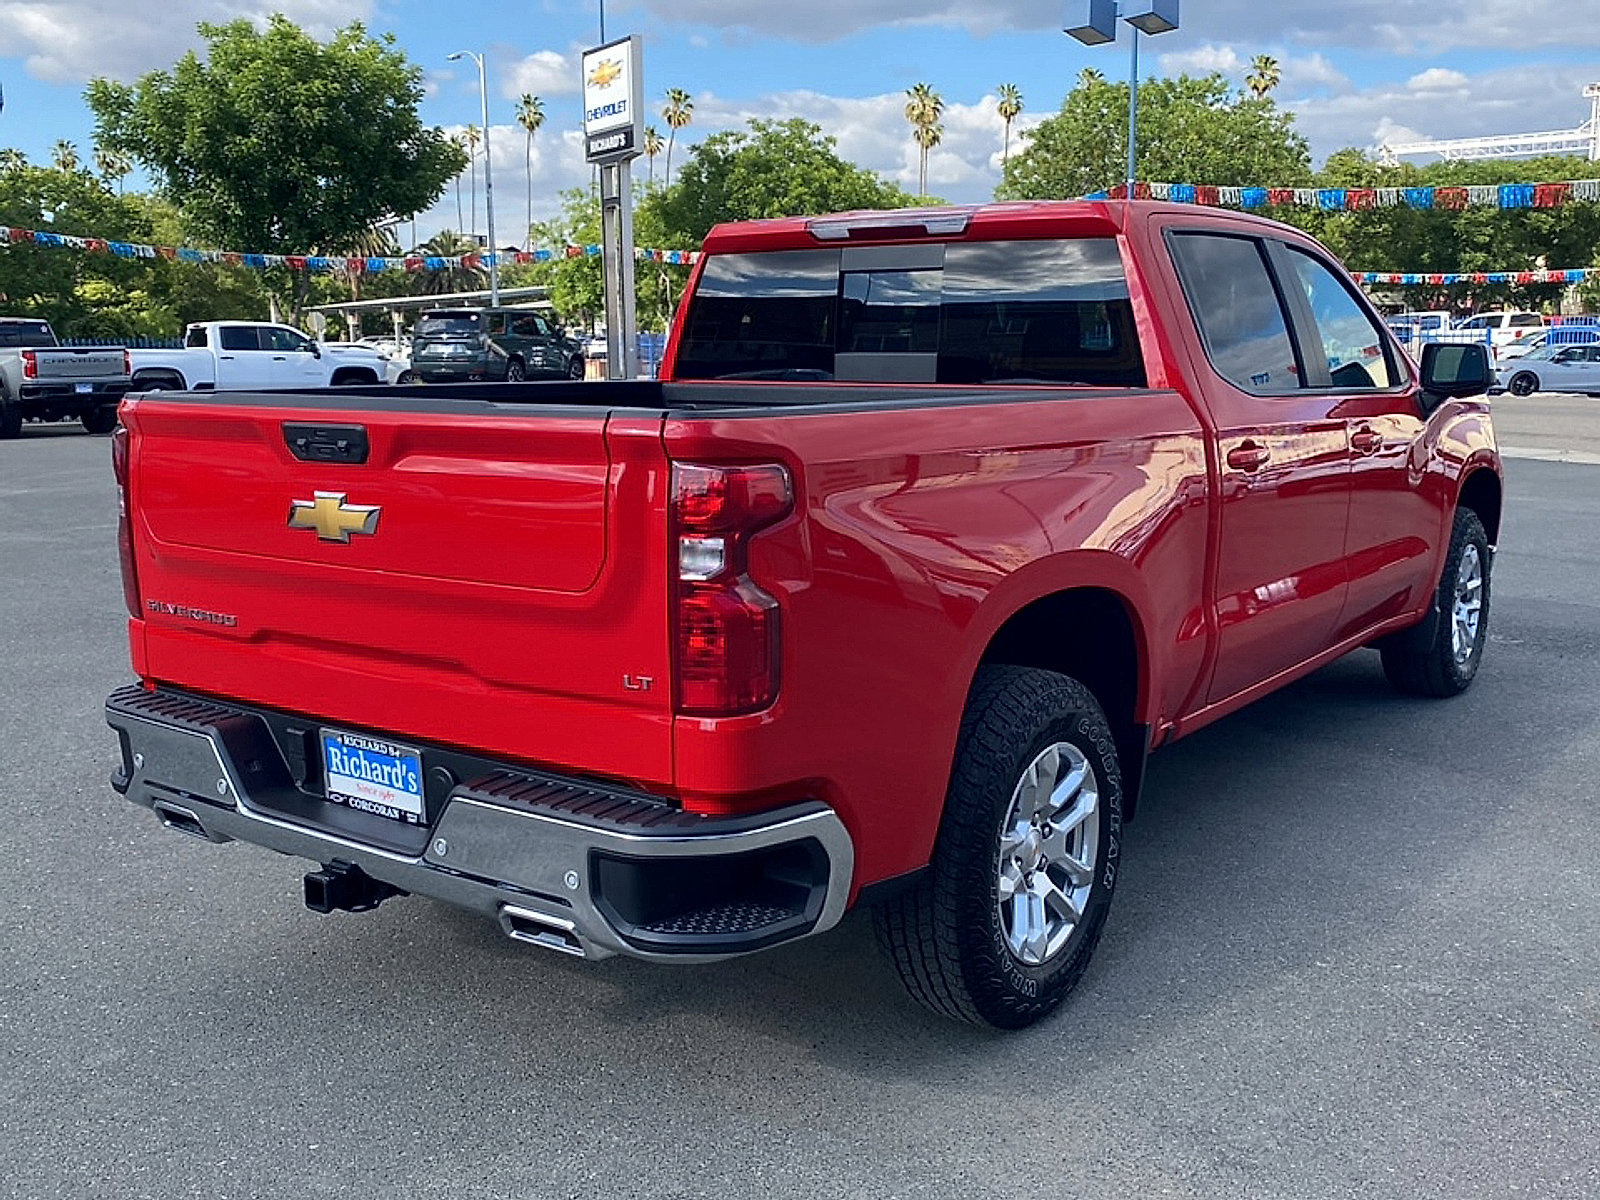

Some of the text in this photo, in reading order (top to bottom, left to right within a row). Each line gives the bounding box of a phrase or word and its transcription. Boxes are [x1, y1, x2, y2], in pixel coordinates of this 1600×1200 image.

[586, 99, 627, 122] CHEVROLET
[623, 673, 653, 691] LT
[328, 746, 418, 793] Richard's
[348, 796, 400, 820] CORCORAN
